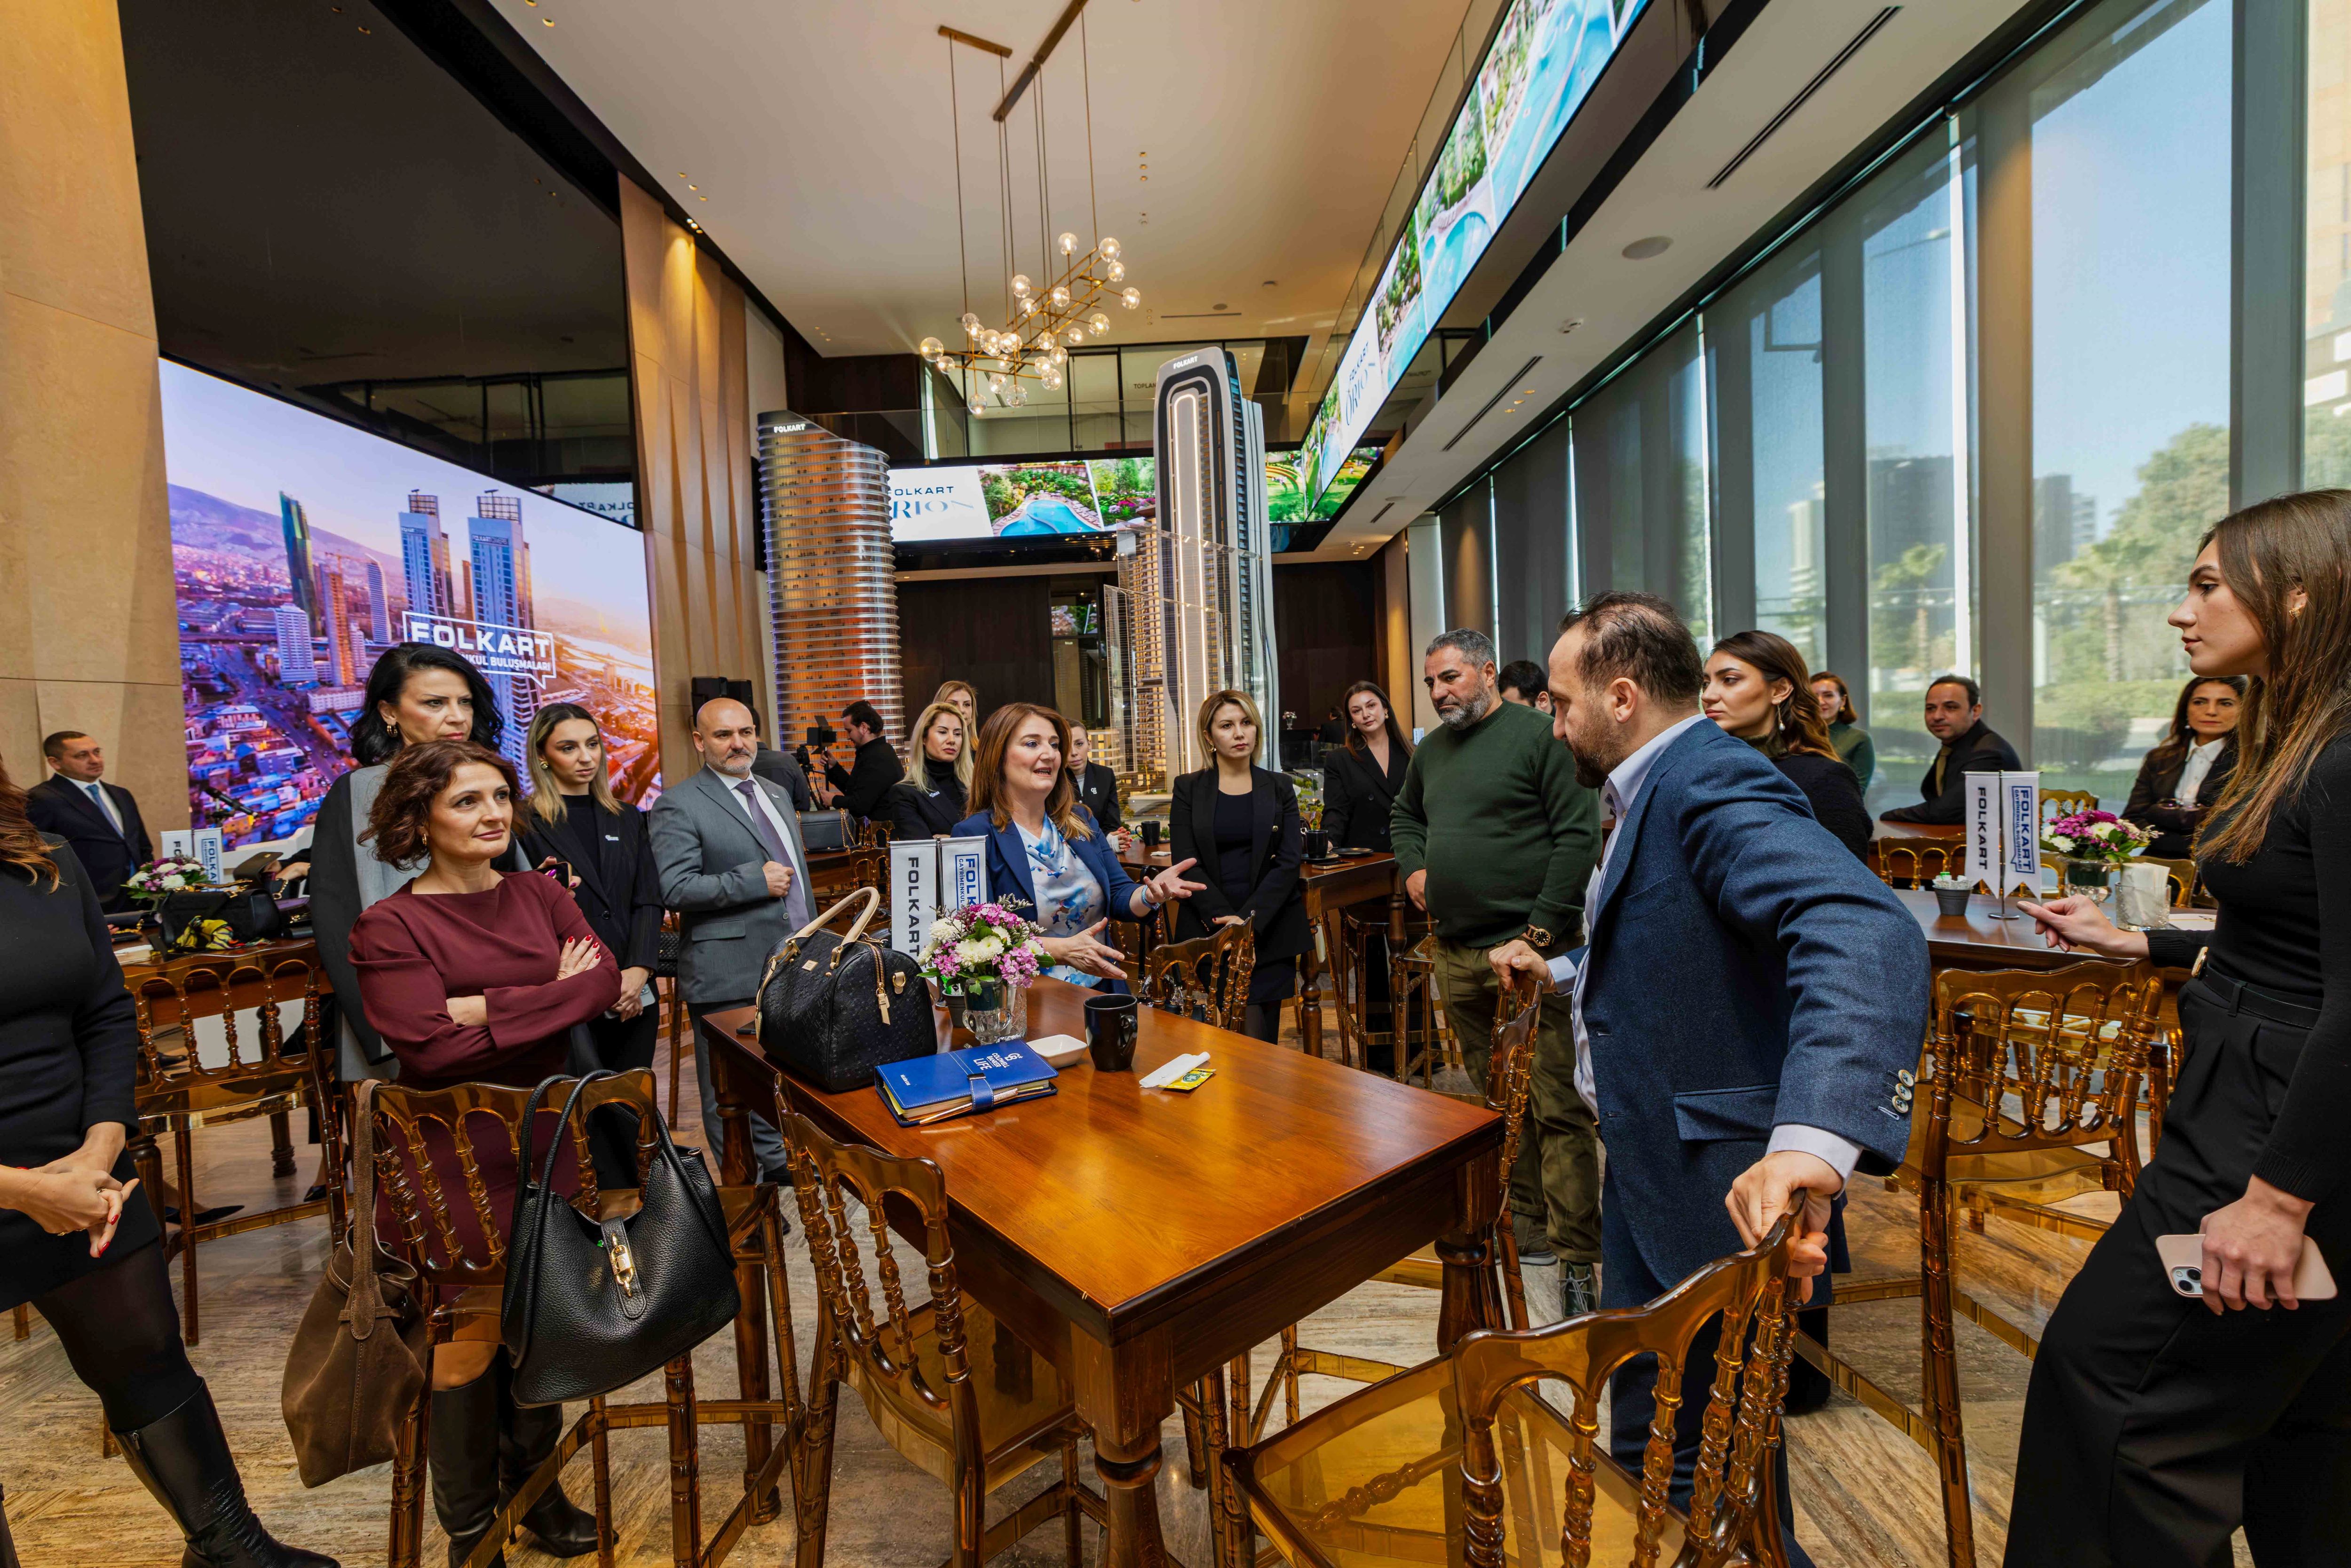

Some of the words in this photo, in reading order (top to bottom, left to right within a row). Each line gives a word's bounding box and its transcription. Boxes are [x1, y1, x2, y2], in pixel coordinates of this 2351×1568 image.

[1173, 356, 1198, 369] FOLKART
[773, 423, 806, 434] FOLKART
[893, 500, 974, 519] RION
[411, 621, 550, 658] FOLKART
[490, 657, 551, 672] BULUŞMALARI
[1978, 787, 1987, 870] FOLKART
[2020, 790, 2032, 870] FOLKART
[208, 840, 217, 884] FOLKA
[966, 858, 976, 906] FOLK
[908, 857, 920, 957] FOLKART
[973, 1058, 992, 1071] LIFE
[986, 1055, 1002, 1068] BANKER
[991, 1053, 1010, 1069] COLDWELL
